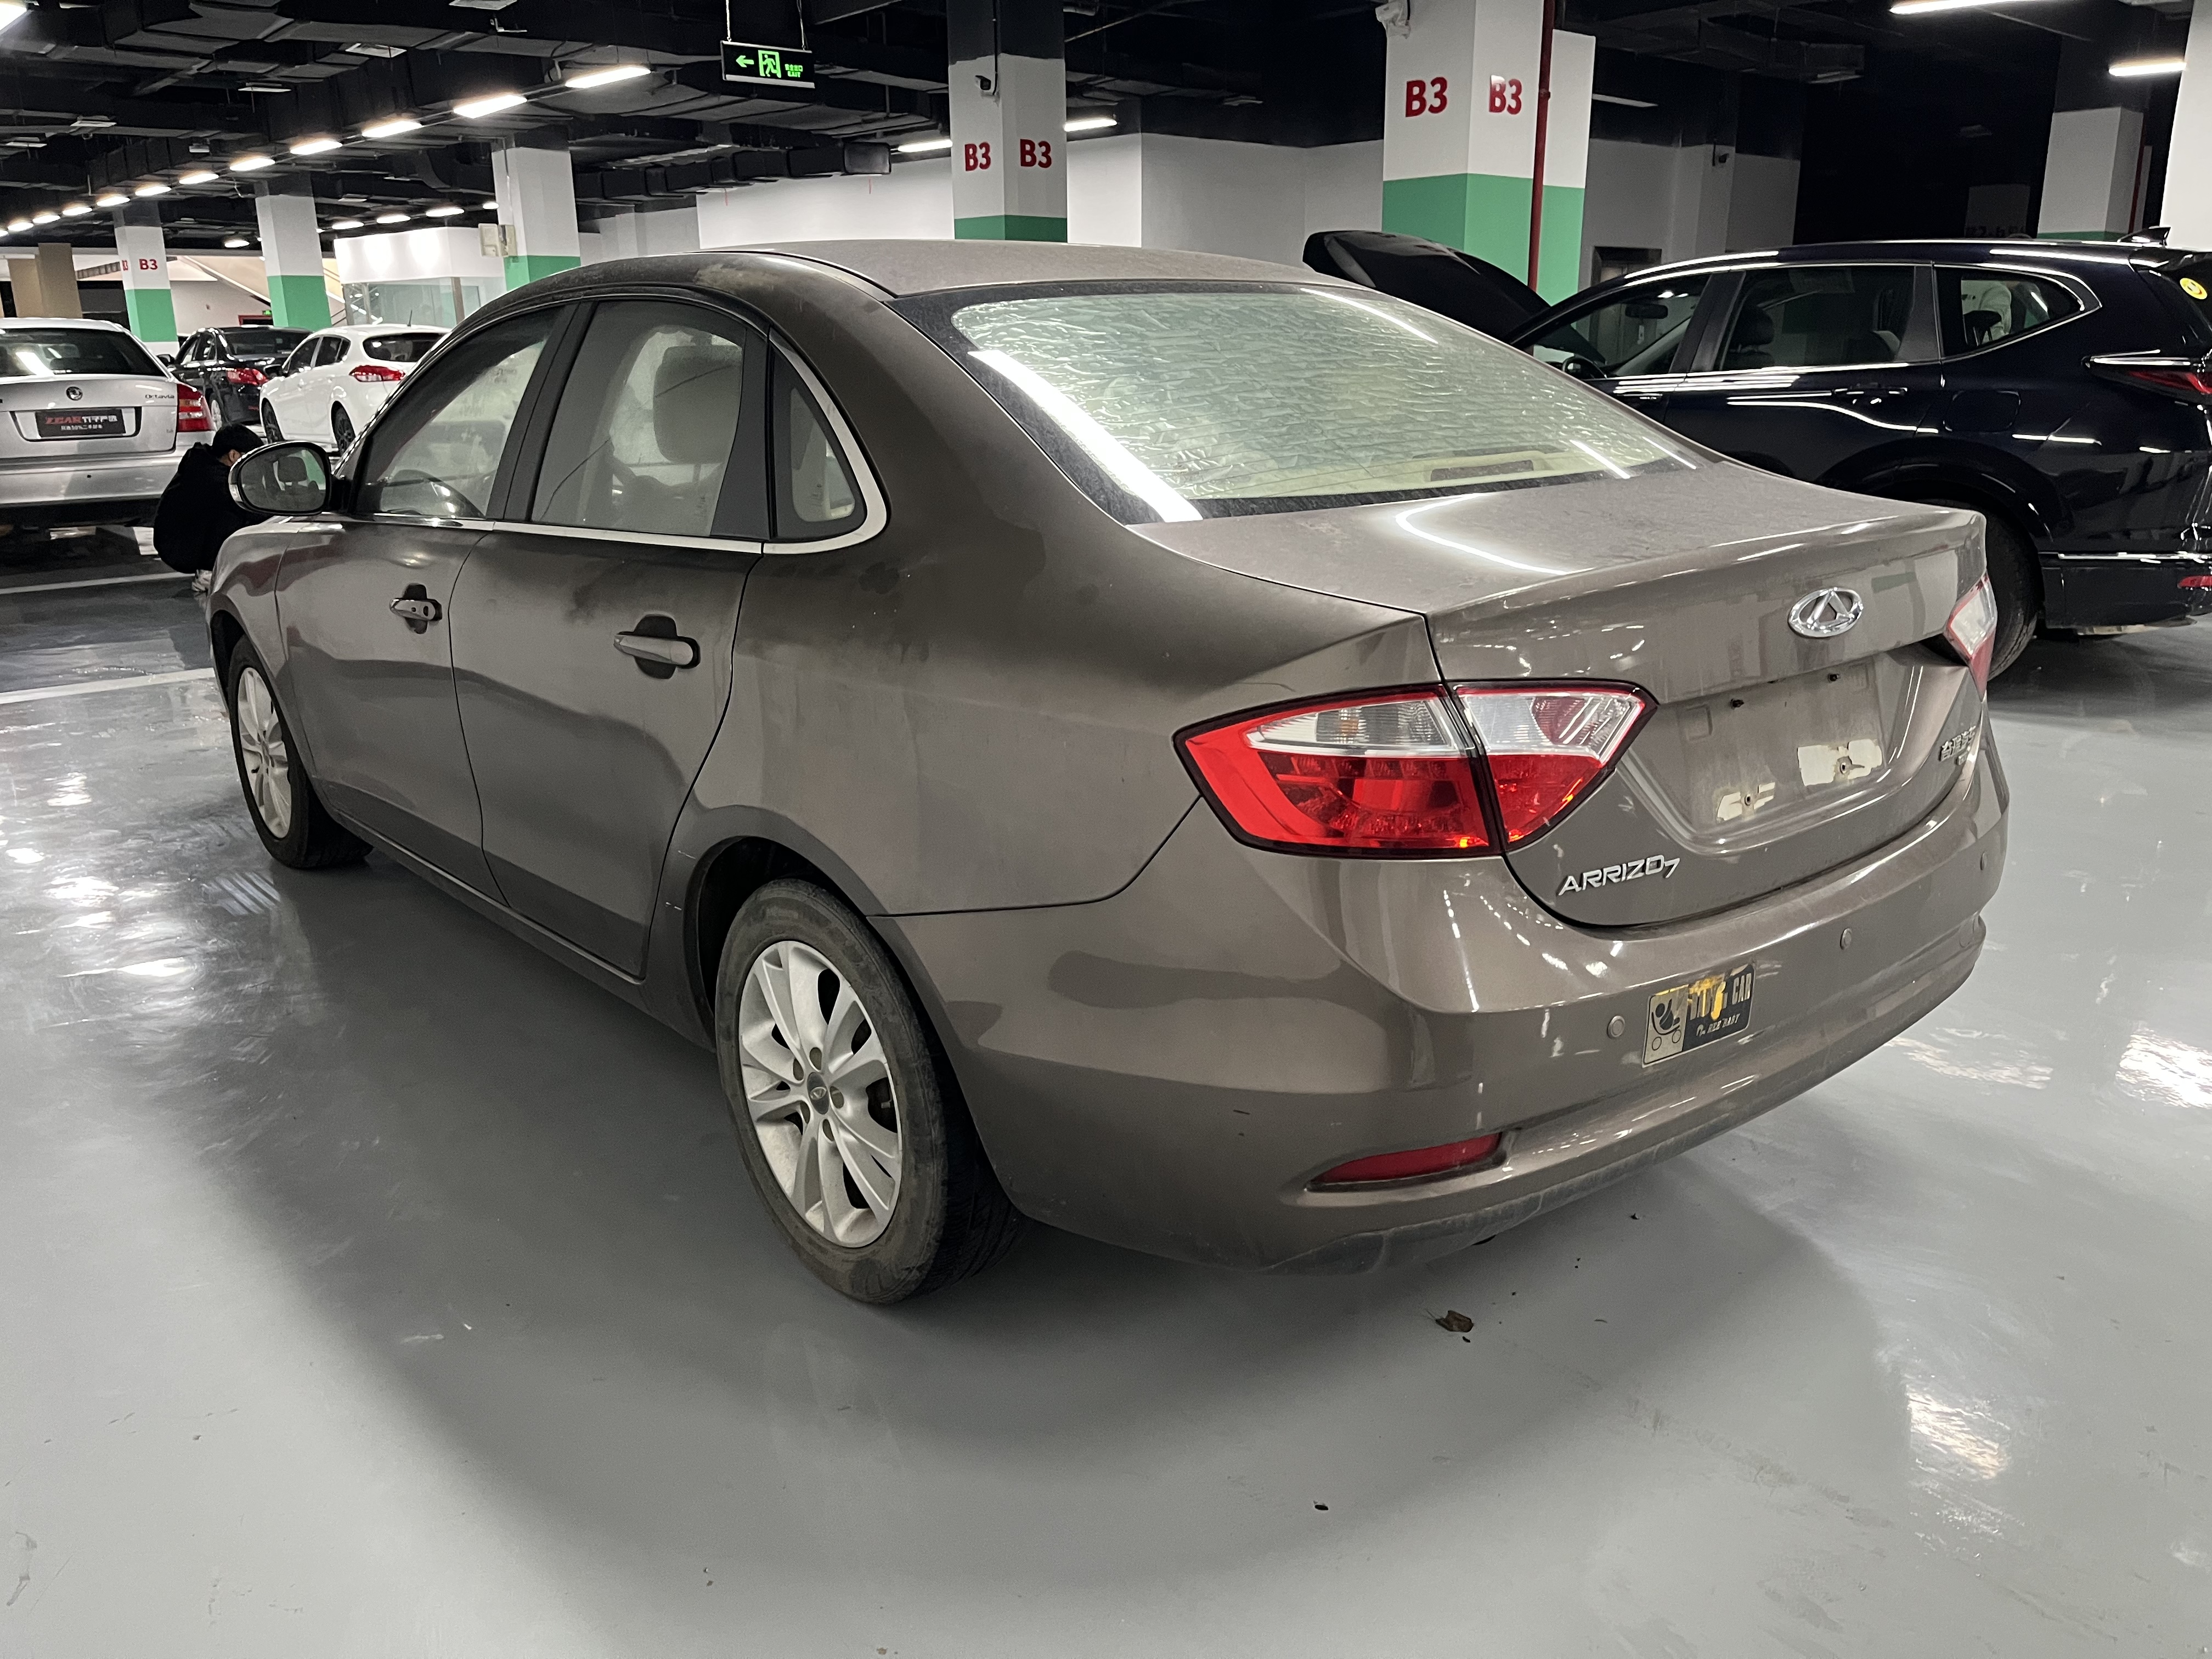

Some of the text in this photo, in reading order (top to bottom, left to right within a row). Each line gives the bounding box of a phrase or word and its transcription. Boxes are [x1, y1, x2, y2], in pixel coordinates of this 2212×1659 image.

[1406, 77, 1447, 117] B3
[1489, 75, 1522, 115] B3
[964, 142, 991, 171] B3
[1020, 139, 1052, 168] B3
[139, 258, 158, 270] B3
[1732, 973, 1752, 1005] CAR
